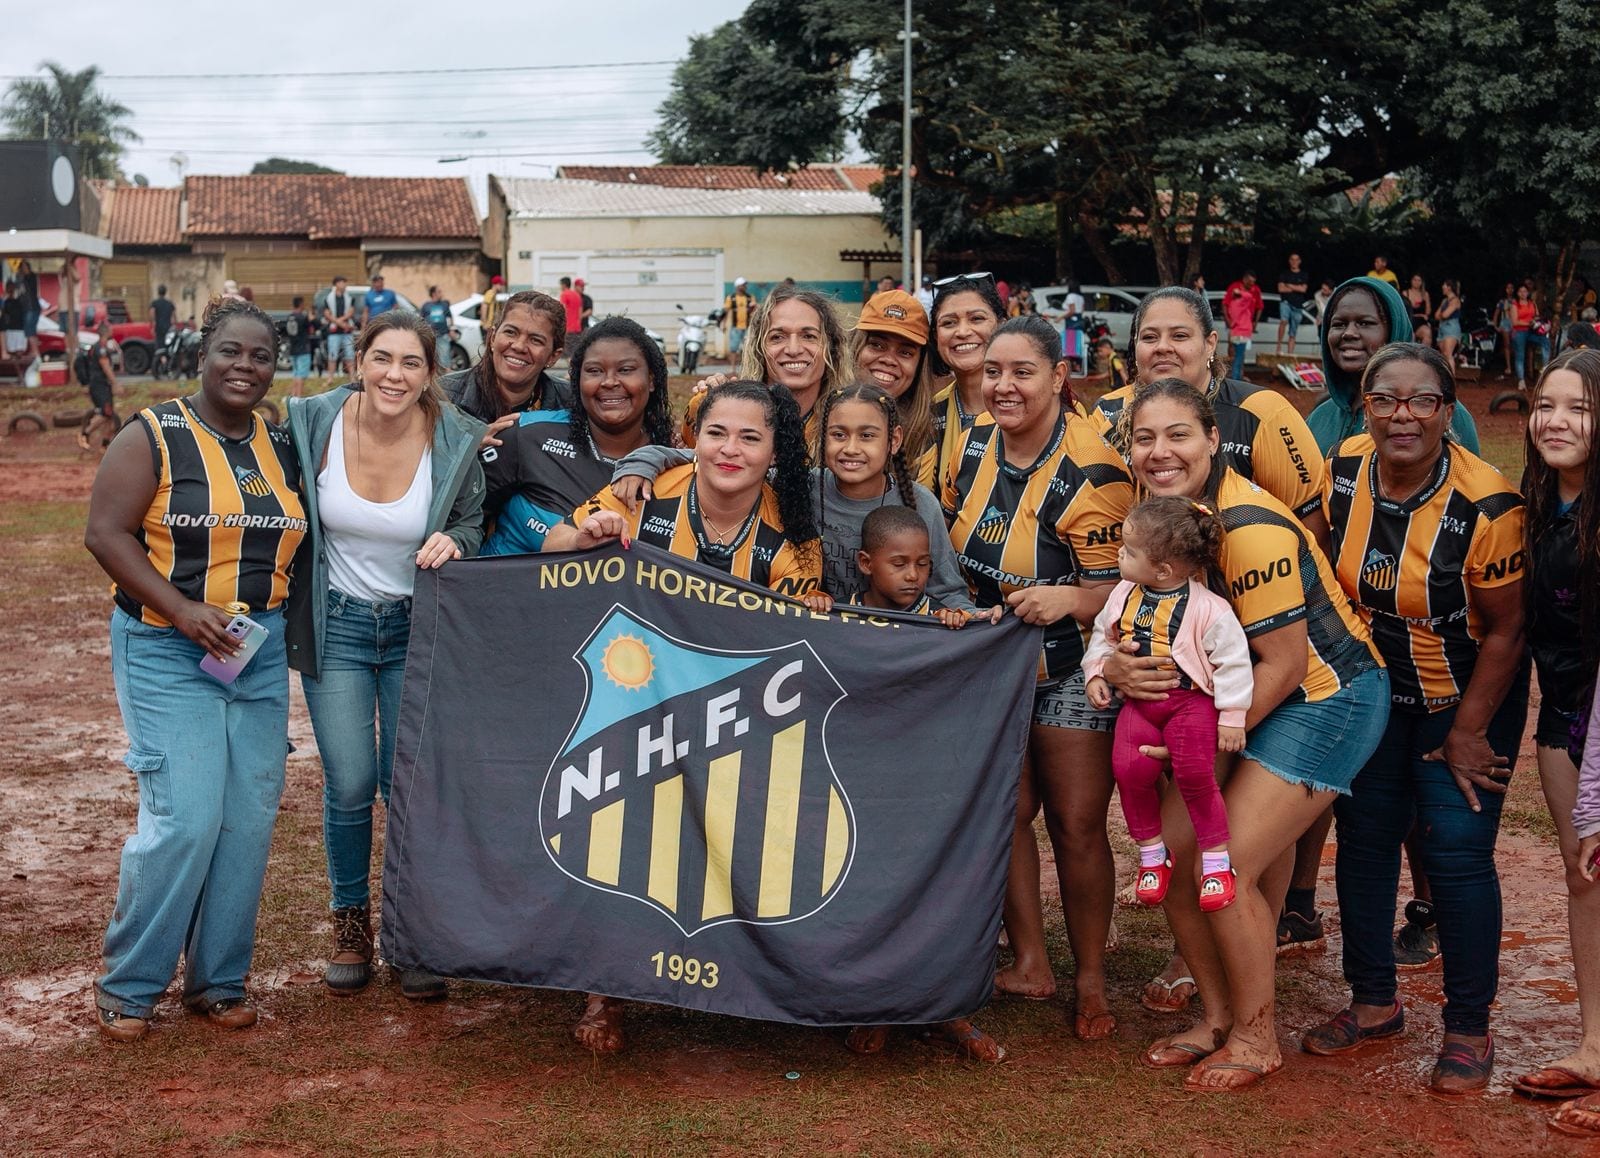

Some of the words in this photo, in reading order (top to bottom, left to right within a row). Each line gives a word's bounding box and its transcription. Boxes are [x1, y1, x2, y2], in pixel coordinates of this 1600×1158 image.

[541, 444, 577, 459] NORTE
[545, 438, 574, 451] ZONA
[1279, 426, 1312, 485] MASTER
[1335, 475, 1356, 488] ZONA
[1302, 499, 1321, 514] NOVO
[161, 513, 220, 528] NOVO
[526, 517, 550, 536] NO
[648, 515, 675, 529] ZONA
[642, 522, 676, 538] NORTE
[540, 556, 626, 590] NOVO
[1231, 557, 1292, 599] NOVO
[651, 951, 719, 988] 1993
